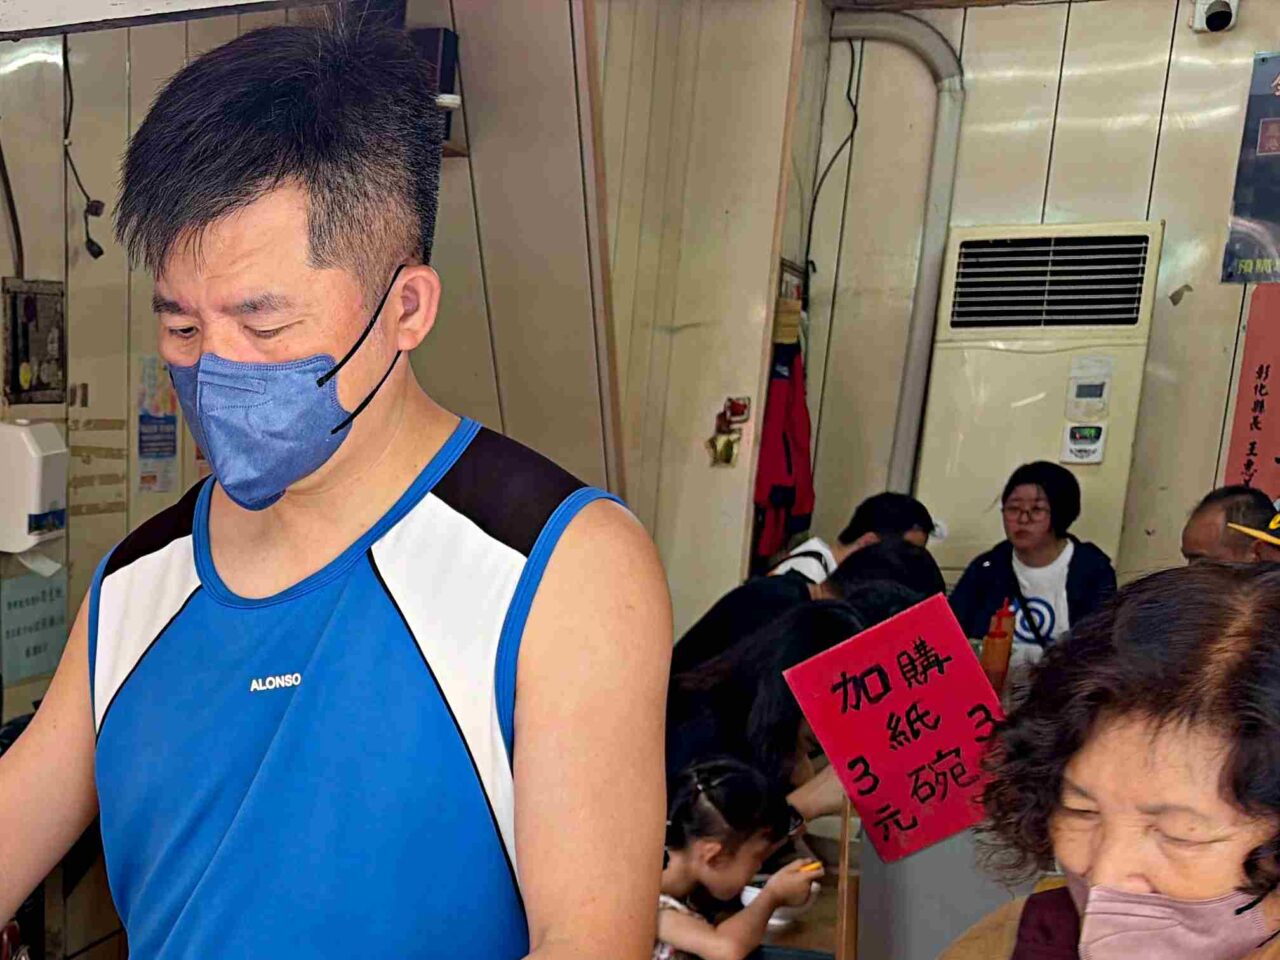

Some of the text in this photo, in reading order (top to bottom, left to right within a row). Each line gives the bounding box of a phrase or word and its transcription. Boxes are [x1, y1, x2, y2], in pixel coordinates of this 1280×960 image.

[250, 672, 302, 692] ALONSO
[830, 635, 952, 714] 加購
[886, 700, 980, 804] 紙碗
[847, 755, 918, 841] 3元
